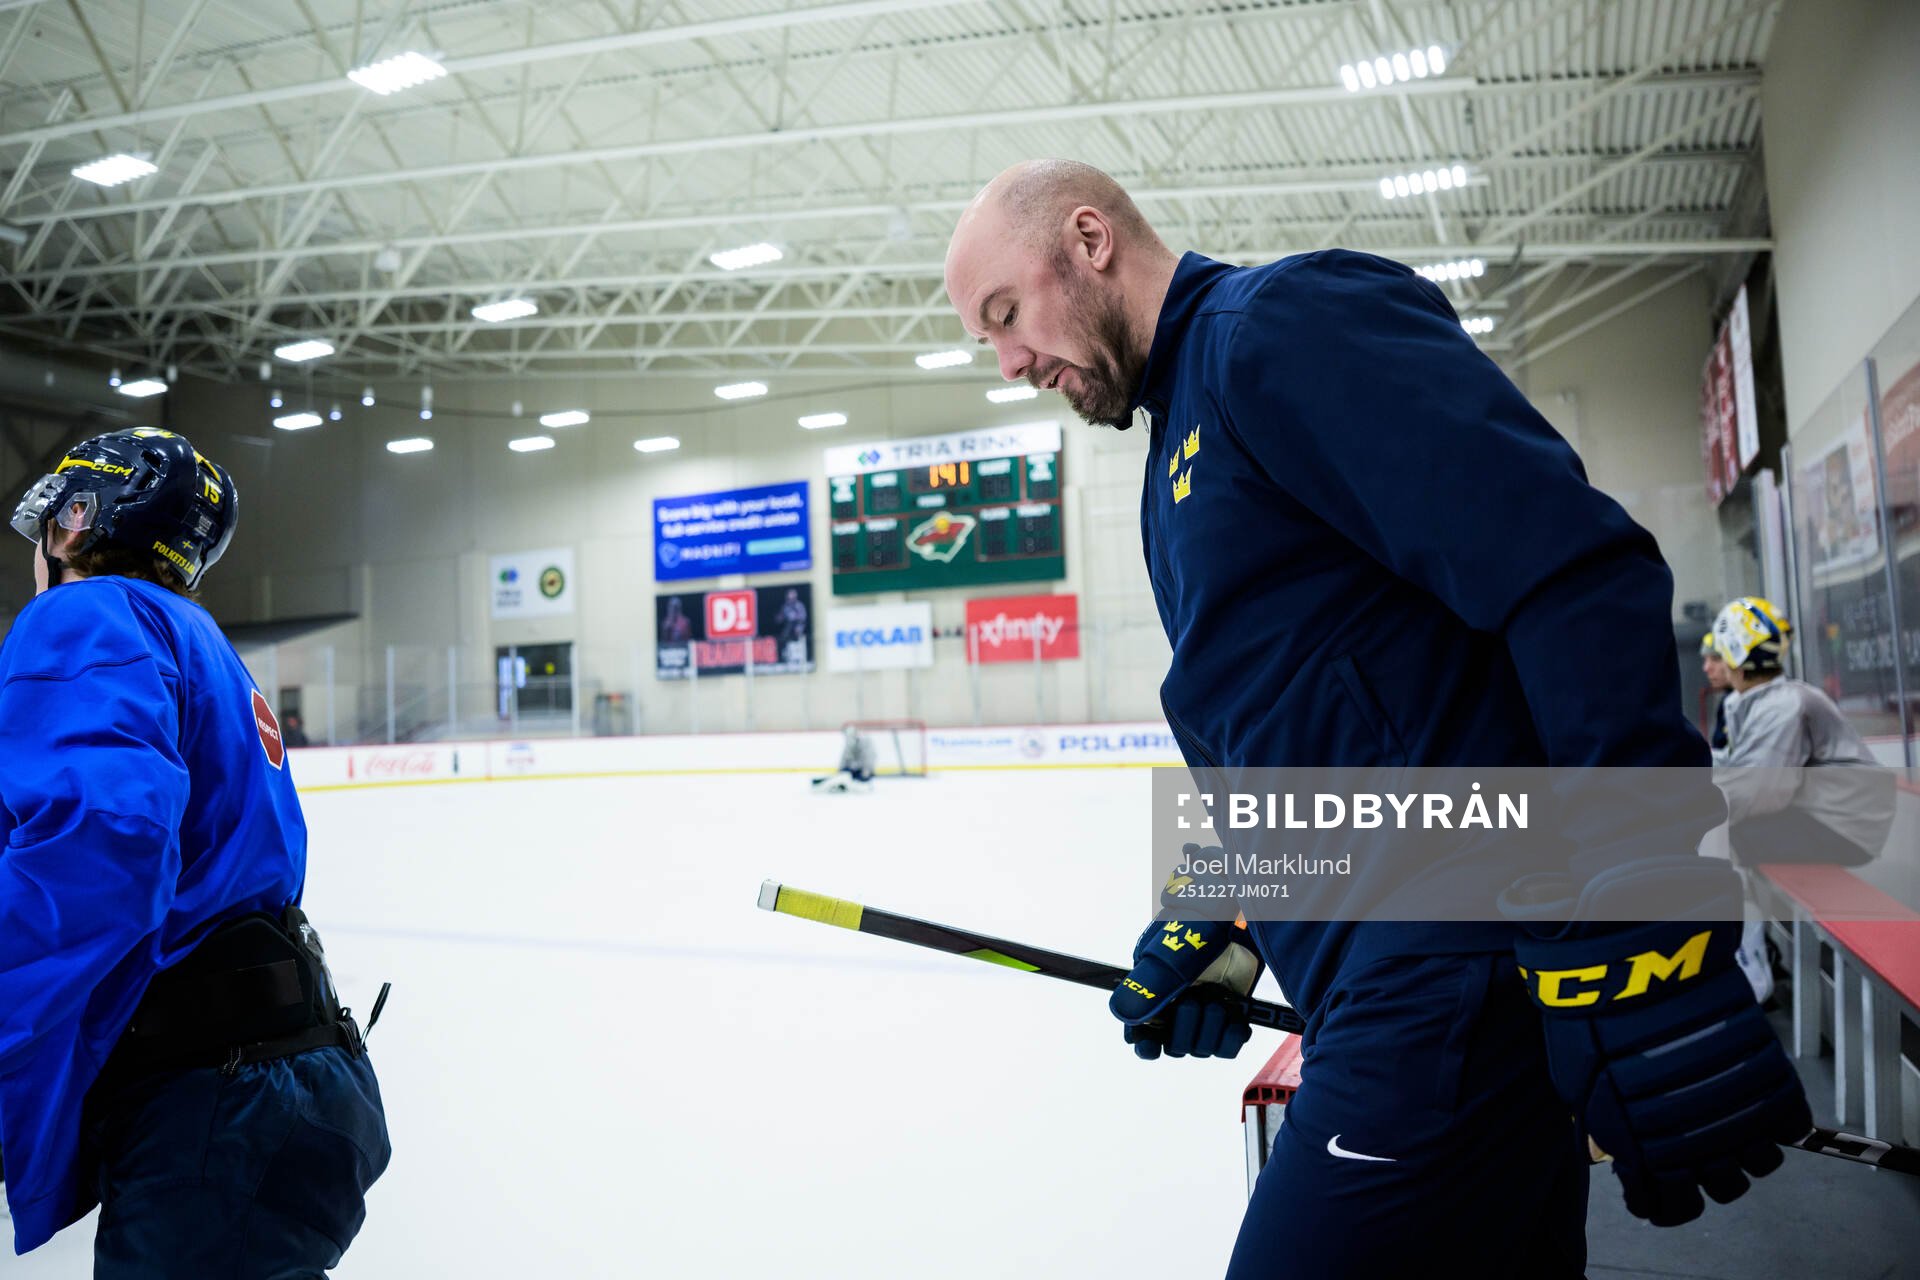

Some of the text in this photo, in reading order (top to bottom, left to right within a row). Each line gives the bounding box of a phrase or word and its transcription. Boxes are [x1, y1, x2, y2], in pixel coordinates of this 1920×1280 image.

[893, 435, 1023, 460] TRIA RINK
[91, 461, 134, 476] CCM
[204, 475, 221, 504] 15
[713, 500, 739, 517] with
[740, 499, 769, 516] your
[152, 540, 188, 568] FOLKETS
[712, 597, 752, 633] D1
[836, 627, 922, 648] ECOLAB
[979, 613, 1065, 647] xfinity
[1518, 930, 1712, 1007] CM
[1122, 978, 1156, 999] CCM
